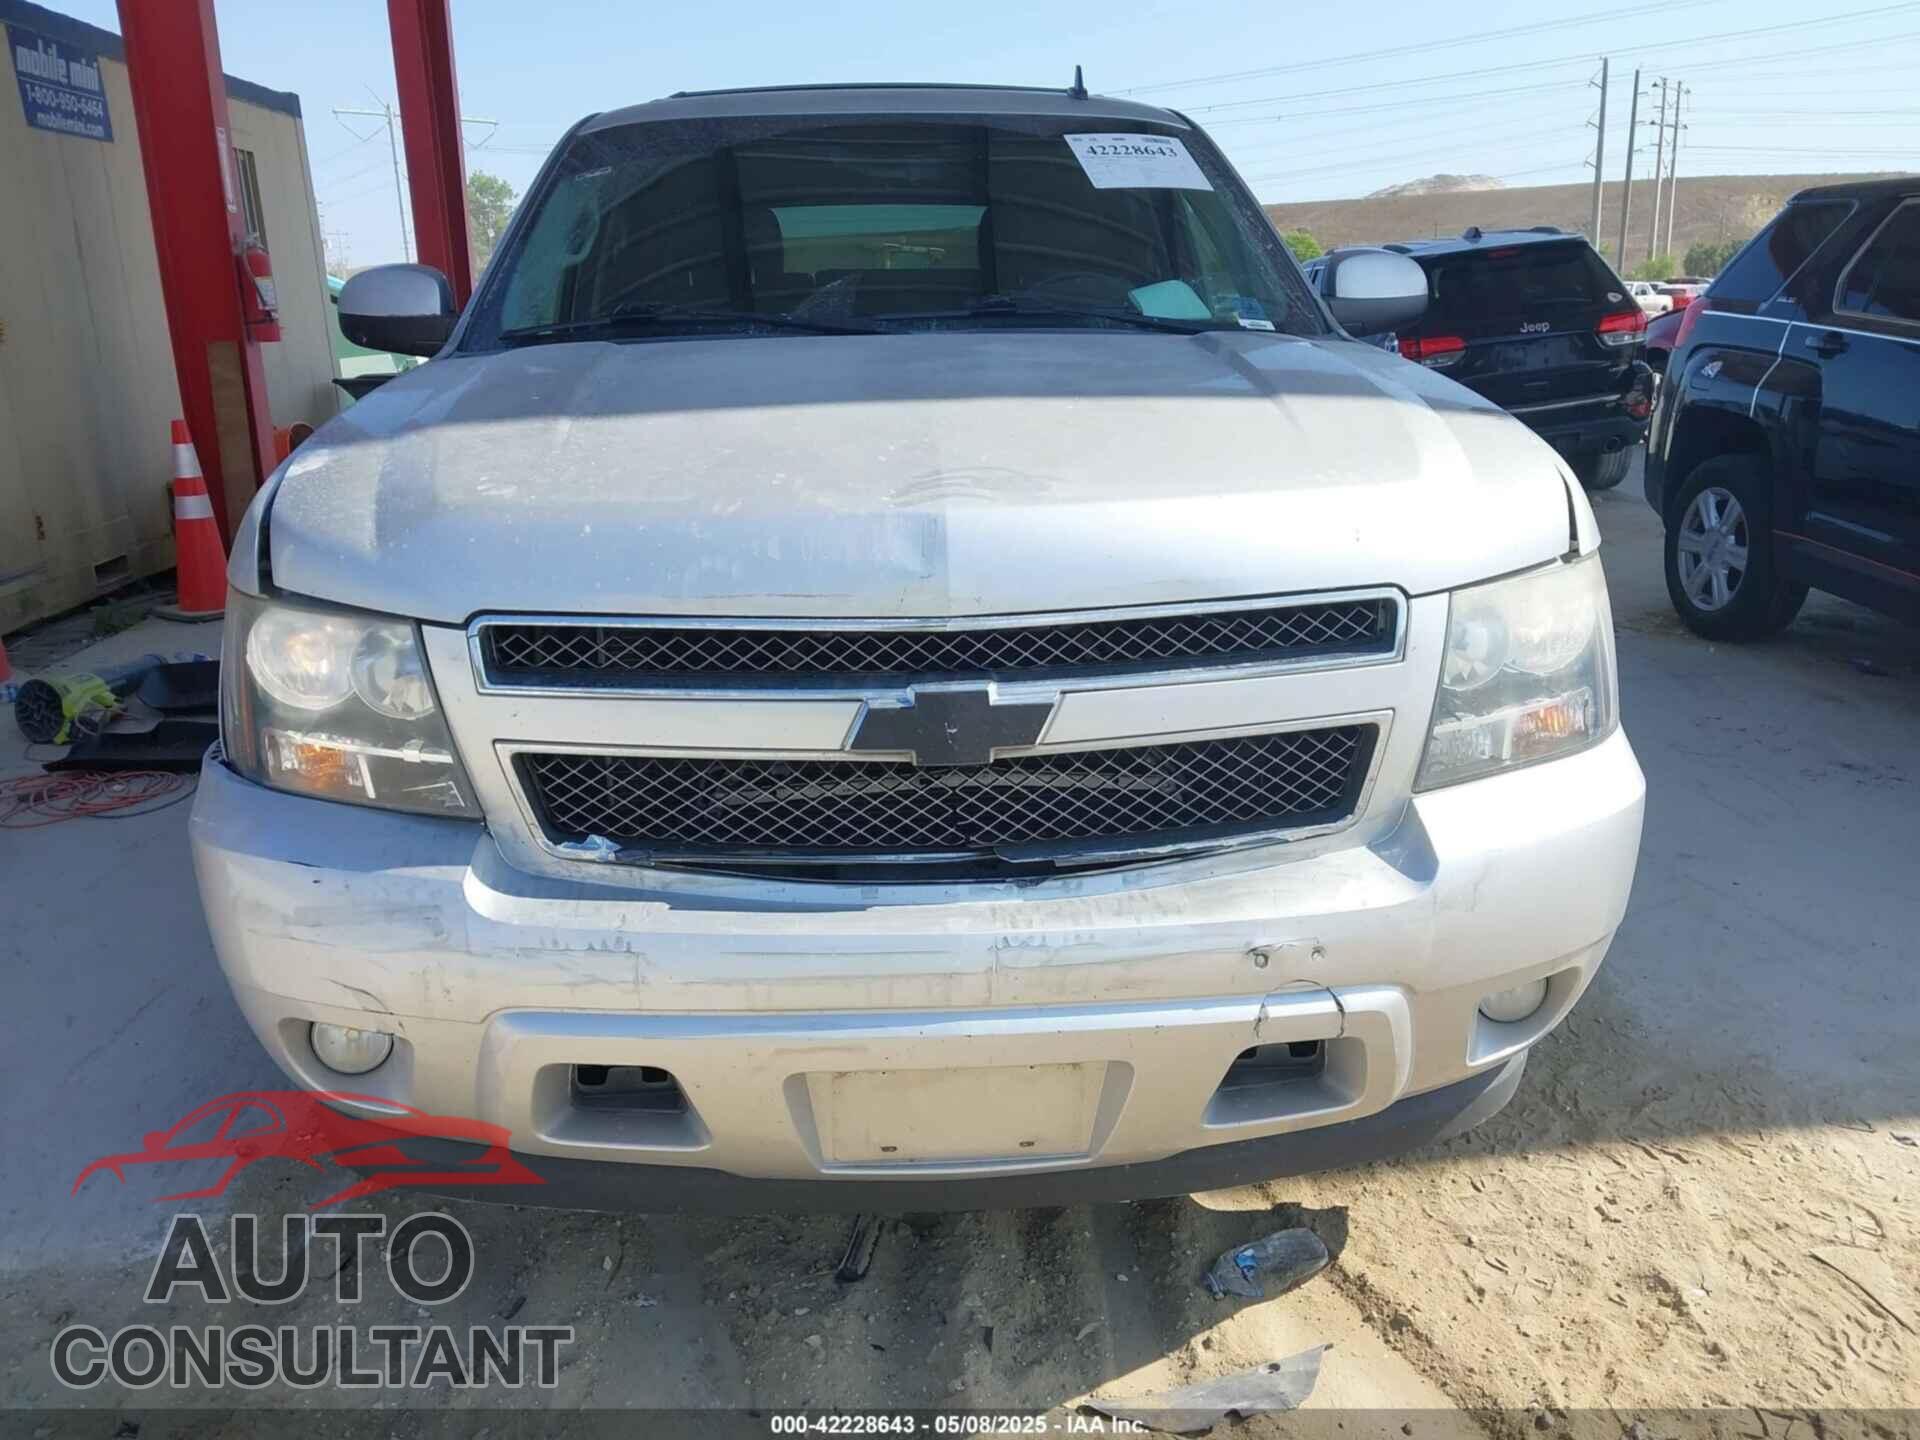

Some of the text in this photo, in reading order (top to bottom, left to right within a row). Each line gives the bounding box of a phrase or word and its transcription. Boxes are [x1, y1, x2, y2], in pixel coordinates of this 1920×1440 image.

[16, 40, 99, 92] mobile mini
[1087, 144, 1178, 158] 42228643
[1520, 321, 1550, 333] Jeep
